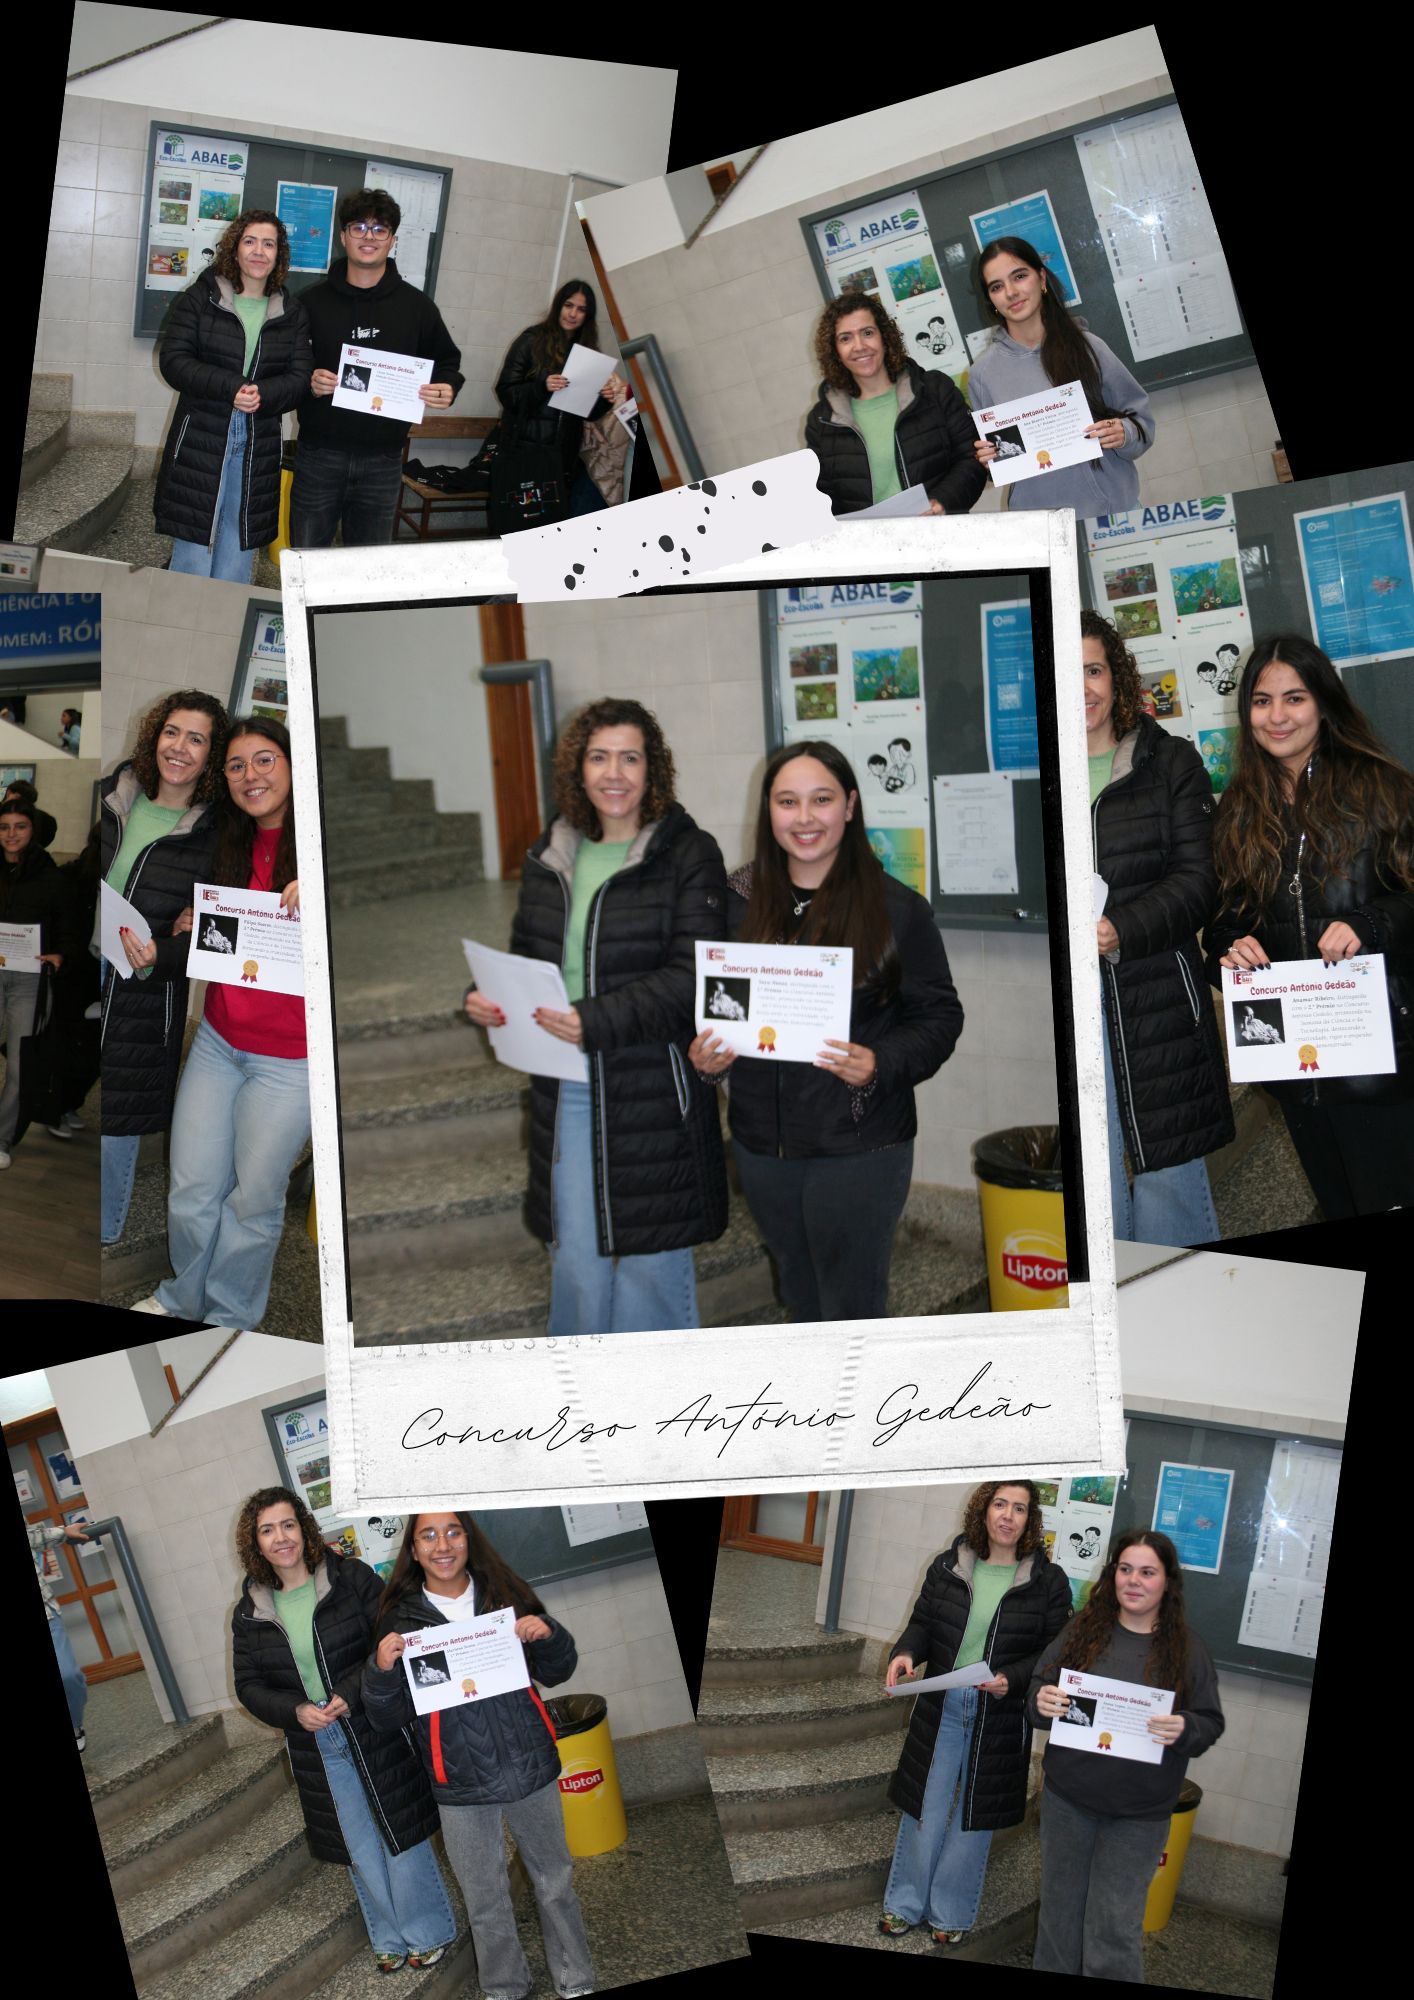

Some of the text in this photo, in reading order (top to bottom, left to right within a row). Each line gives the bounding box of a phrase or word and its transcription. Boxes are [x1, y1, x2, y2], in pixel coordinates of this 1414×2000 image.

[191, 151, 228, 165] ABAE
[860, 215, 901, 241] ABAE
[995, 414, 1021, 428] Concurso
[1142, 499, 1200, 526] ABAE
[831, 583, 888, 603] ABAE
[0, 594, 60, 613] IÊNCIA
[0, 632, 53, 648] MEM:
[215, 904, 246, 915] Concurso
[722, 964, 758, 974] Concurso
[1250, 985, 1288, 996] Concurso
[1325, 980, 1356, 990] Gedeão
[1007, 1257, 1067, 1282] Lipton
[421, 1641, 448, 1652] Concurso
[1077, 1687, 1104, 1698] Concurso
[562, 1773, 601, 1791] Lipton
